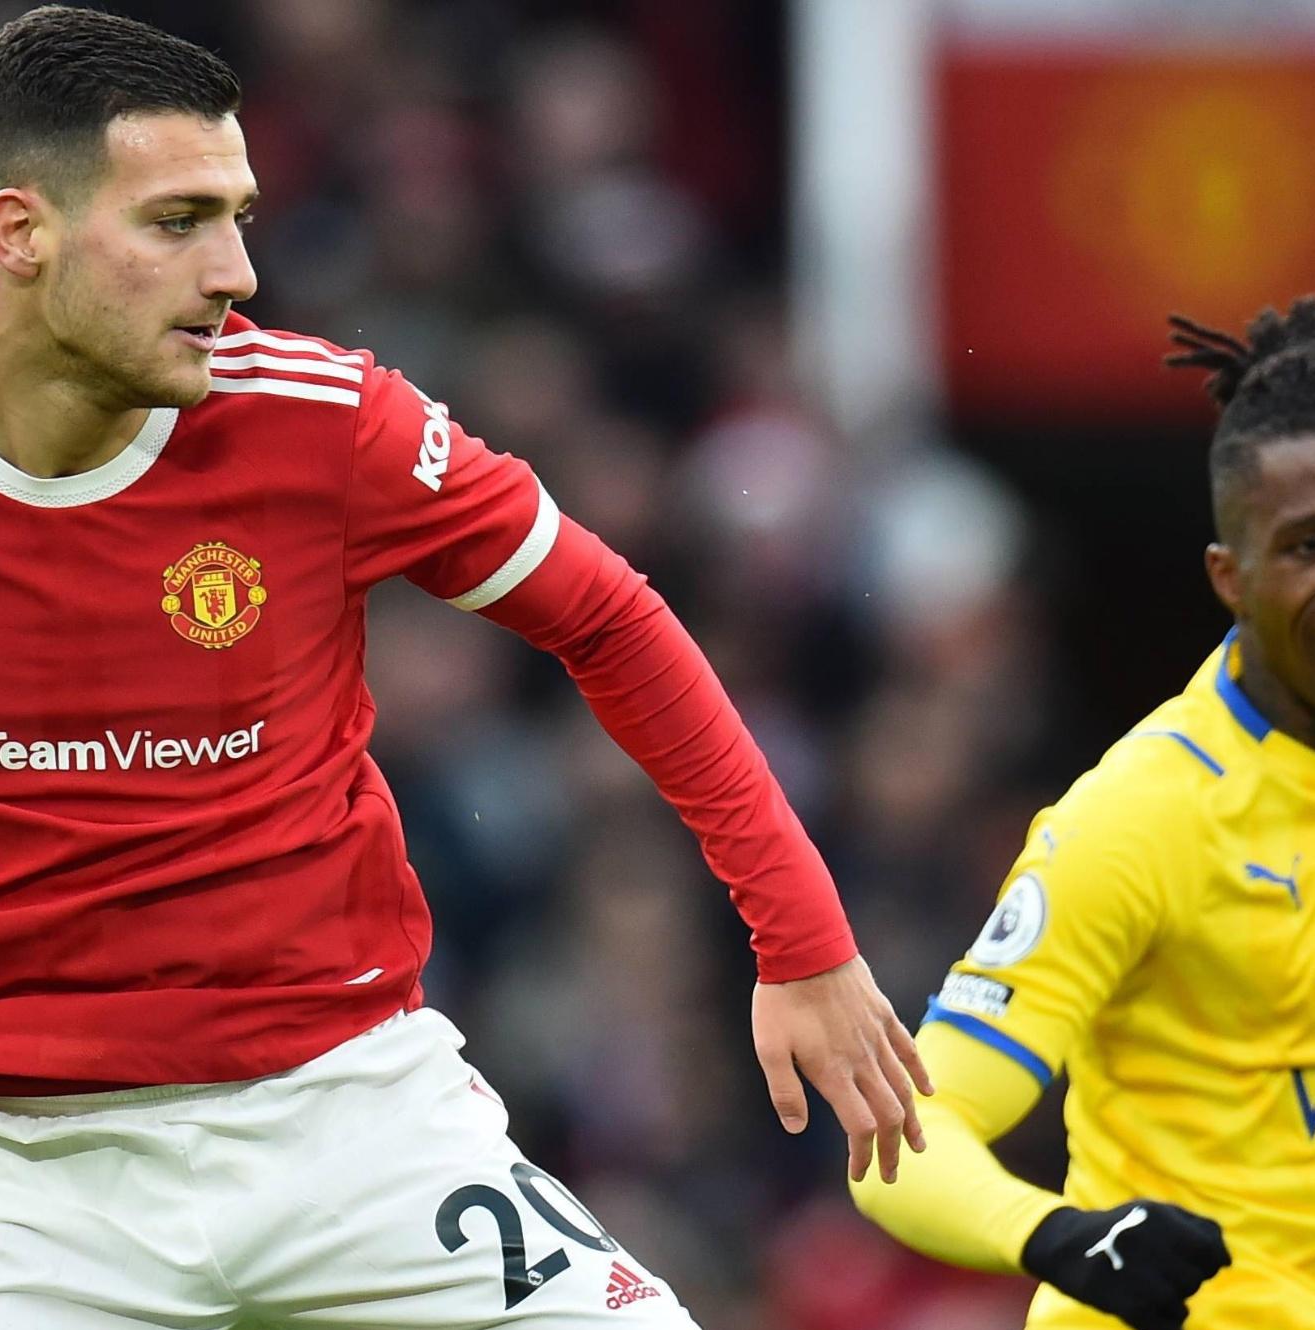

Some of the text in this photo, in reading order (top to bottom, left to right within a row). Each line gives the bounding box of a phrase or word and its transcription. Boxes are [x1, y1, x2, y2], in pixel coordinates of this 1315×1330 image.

[170, 549, 255, 588] MANCHESTER
[188, 620, 247, 642] UNITED
[434, 1161, 619, 1311] 20
